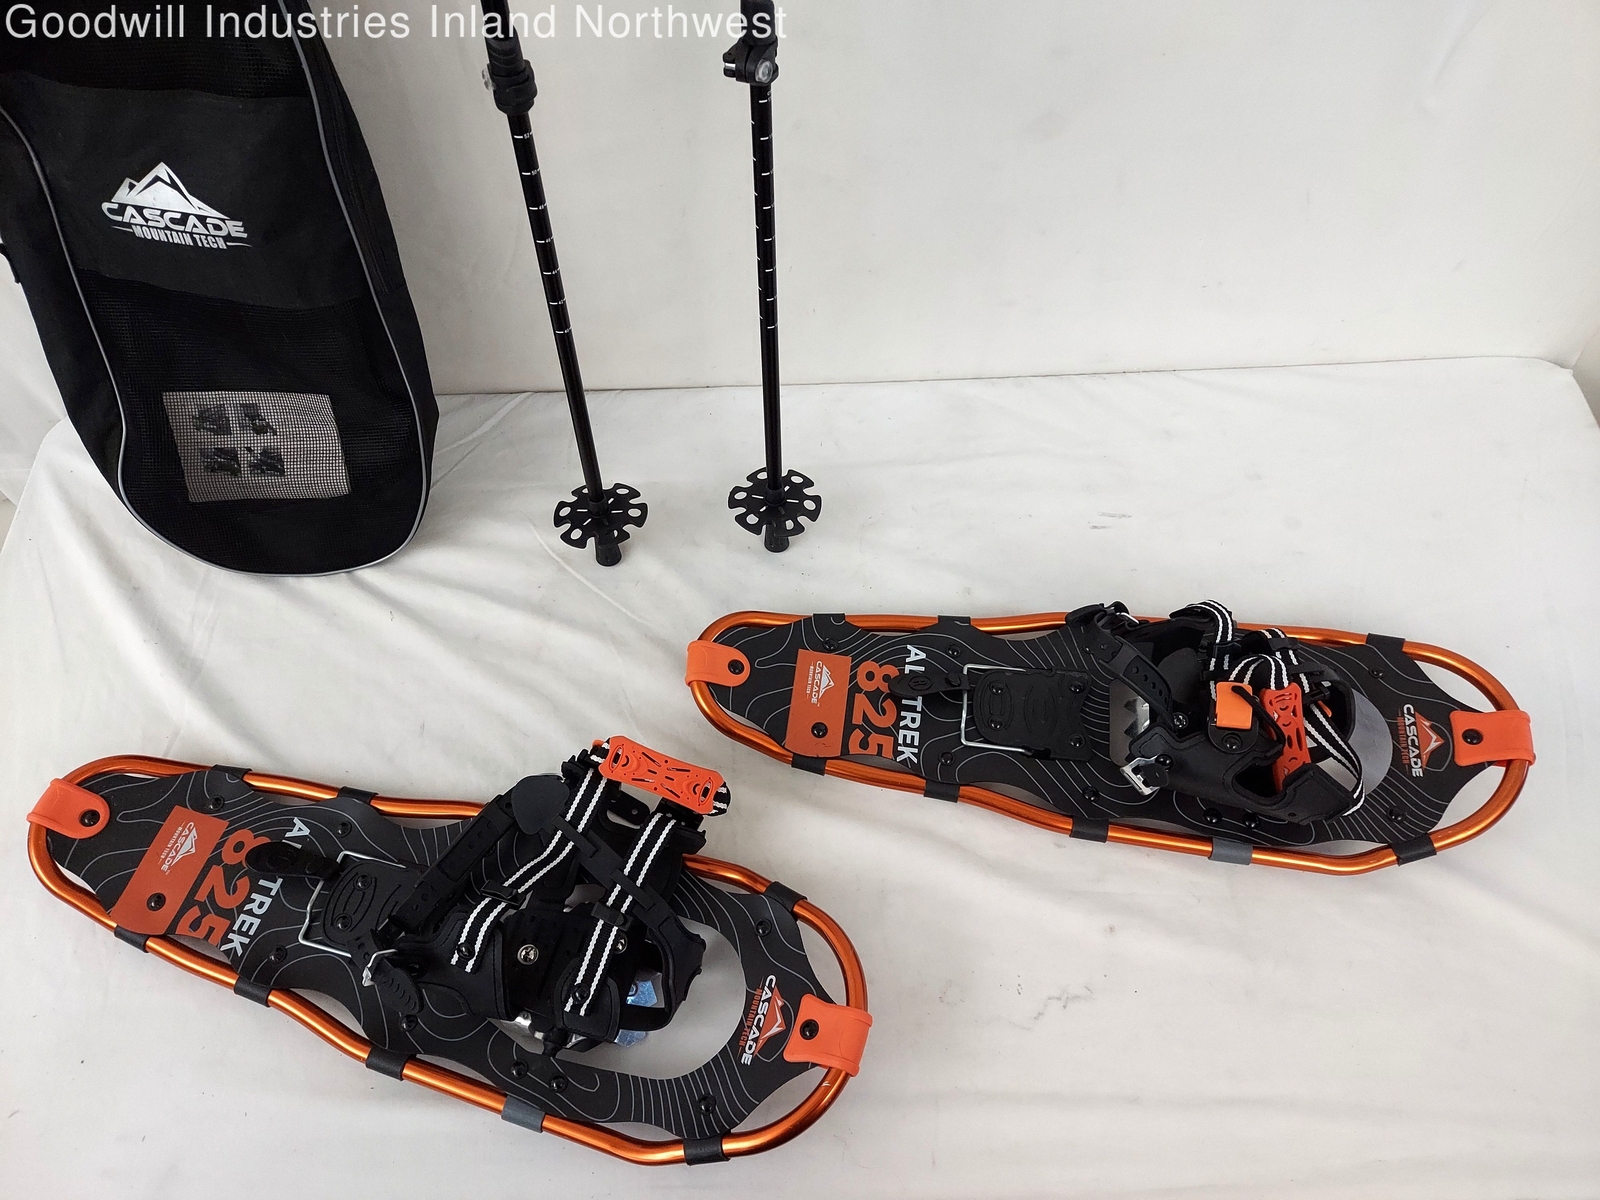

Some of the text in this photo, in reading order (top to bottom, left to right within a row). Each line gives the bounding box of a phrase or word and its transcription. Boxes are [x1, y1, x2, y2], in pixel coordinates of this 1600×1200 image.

[101, 202, 248, 239] CASCADE
[131, 225, 227, 250] MOUNTAIN TECH
[811, 660, 823, 704] CASCADE
[848, 660, 900, 760] 825
[896, 644, 926, 764] ALTREK
[1403, 704, 1424, 777] CASCADE
[161, 822, 194, 872] CASCADE
[175, 828, 272, 945] 825
[738, 988, 763, 1047] MOUNTAIN TECH
[741, 974, 777, 1066] CASCADE
